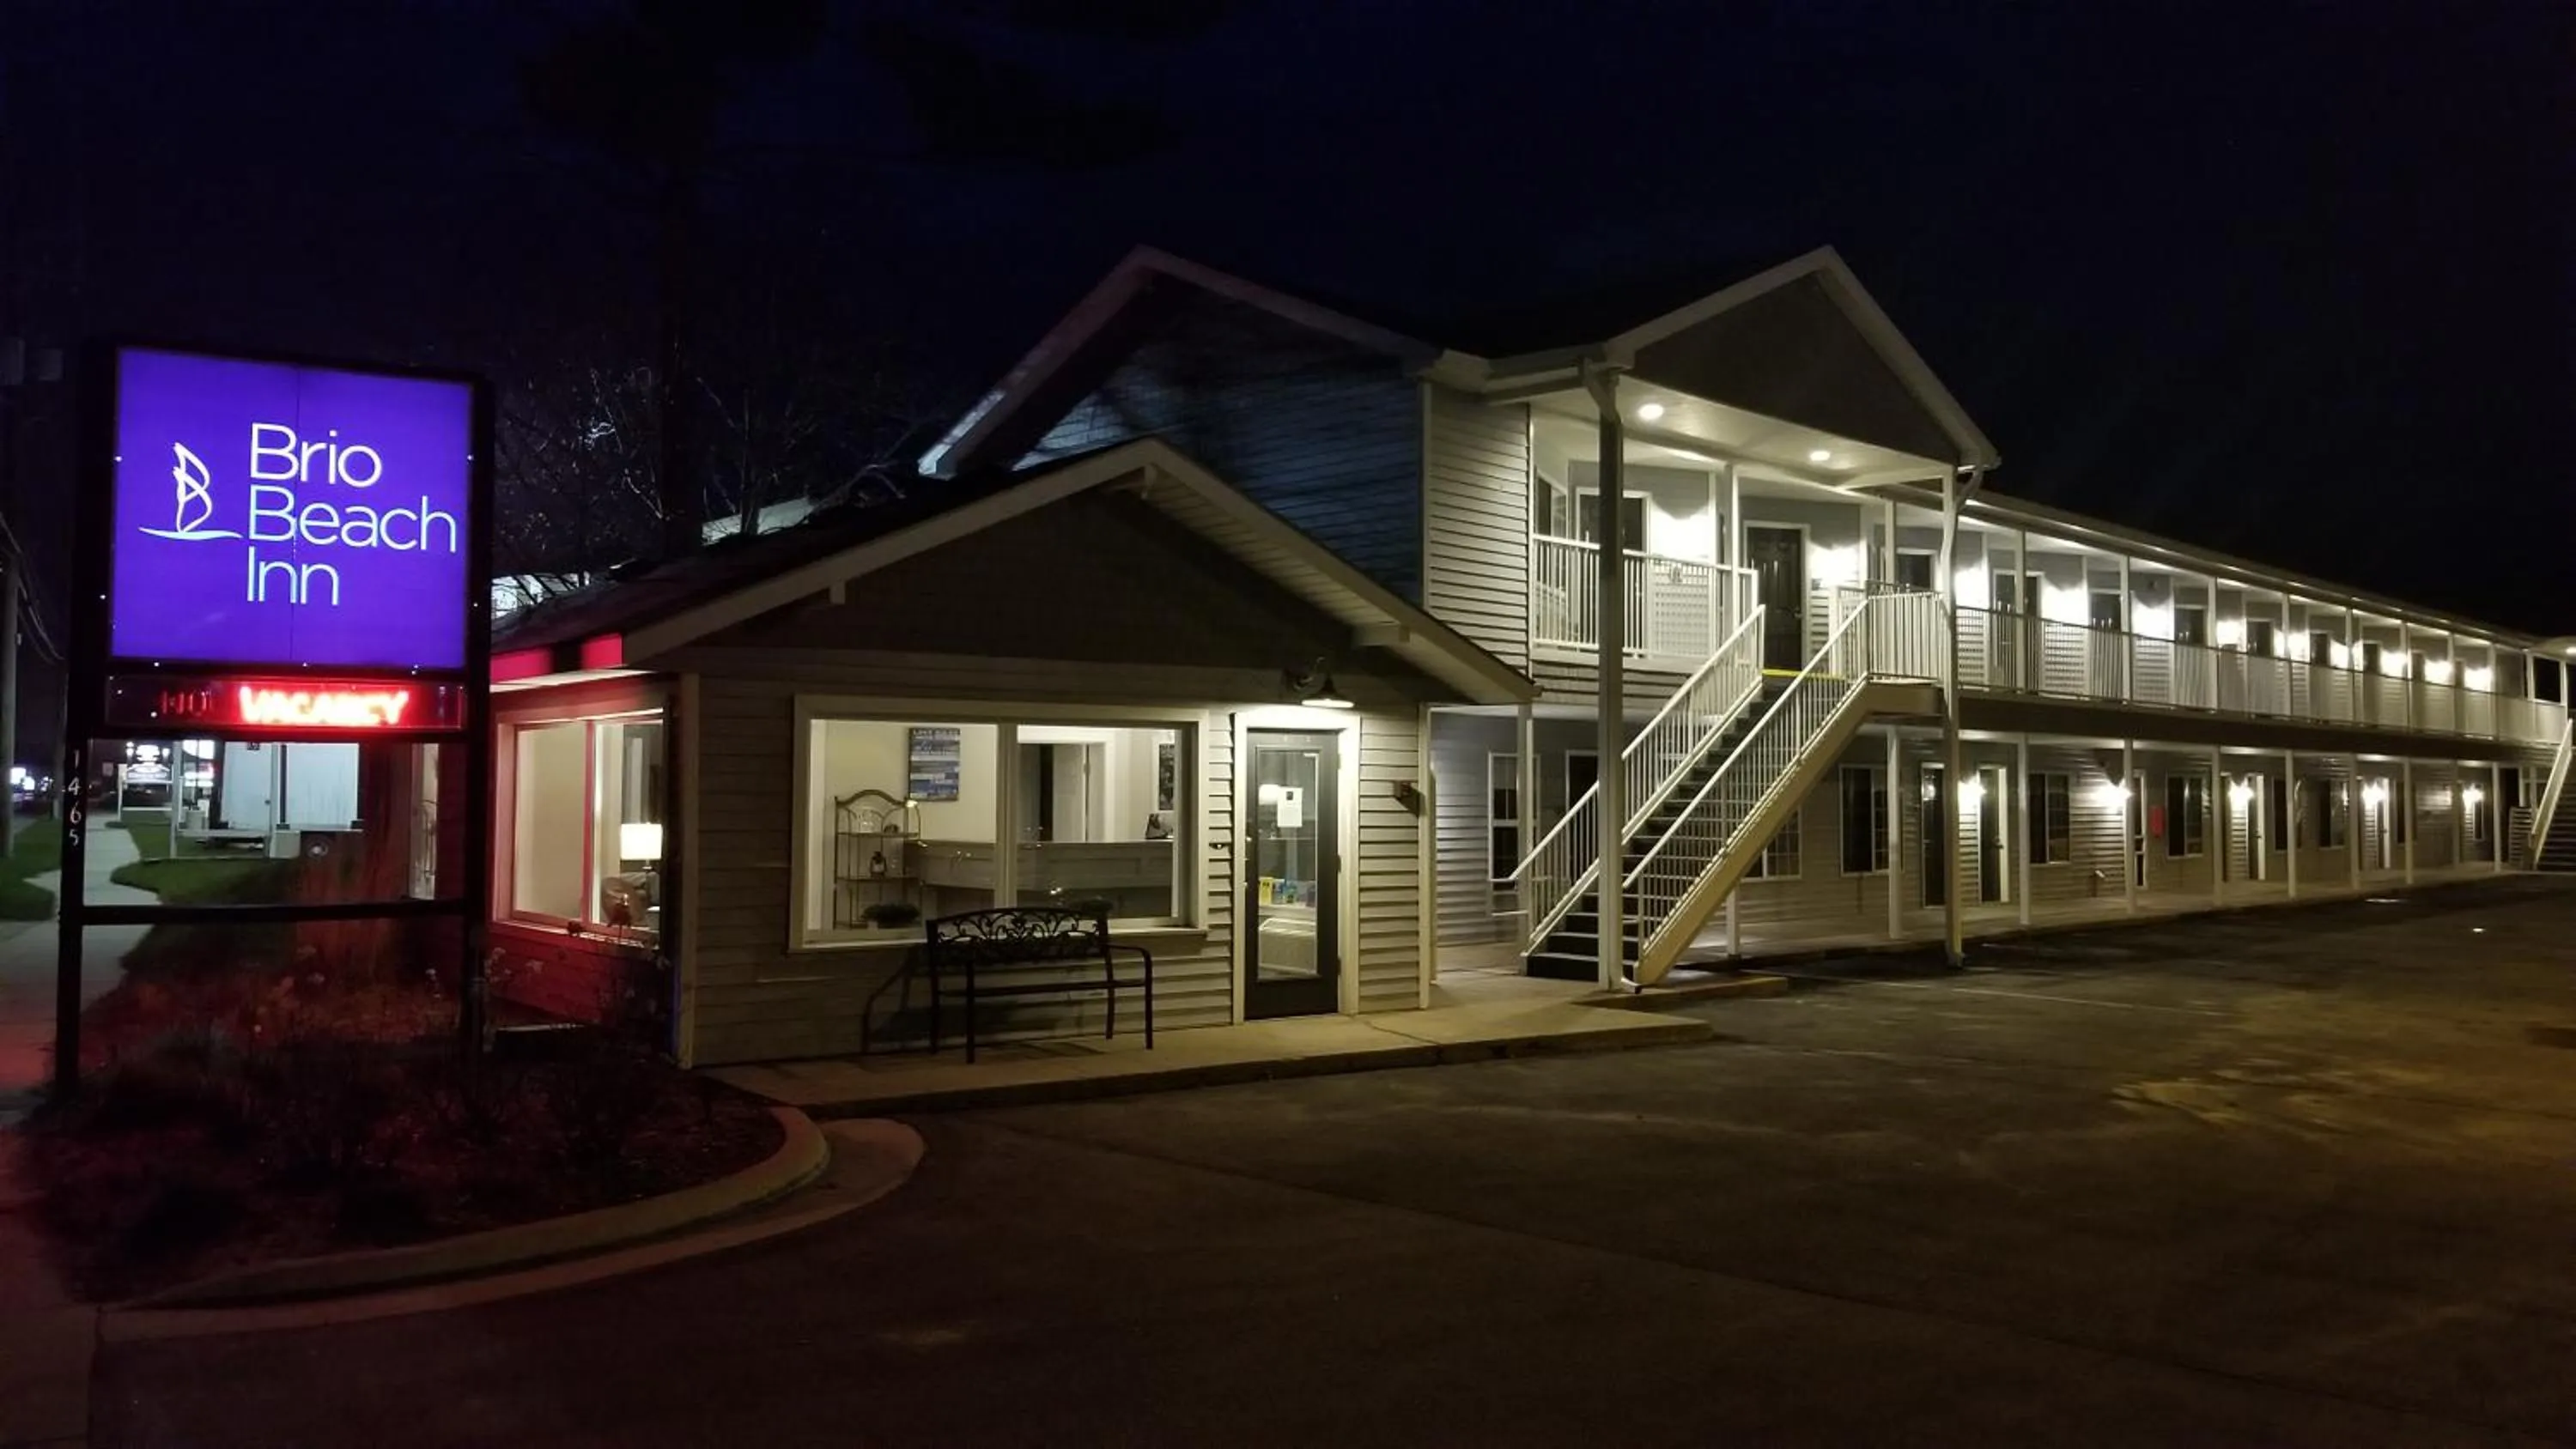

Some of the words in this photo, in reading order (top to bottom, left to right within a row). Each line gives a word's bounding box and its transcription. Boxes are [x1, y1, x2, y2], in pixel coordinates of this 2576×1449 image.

[250, 422, 383, 488] Brio
[248, 483, 457, 554] Beach
[246, 545, 340, 606] Inn
[239, 686, 409, 725] VACANCY
[68, 749, 82, 846] 1465
